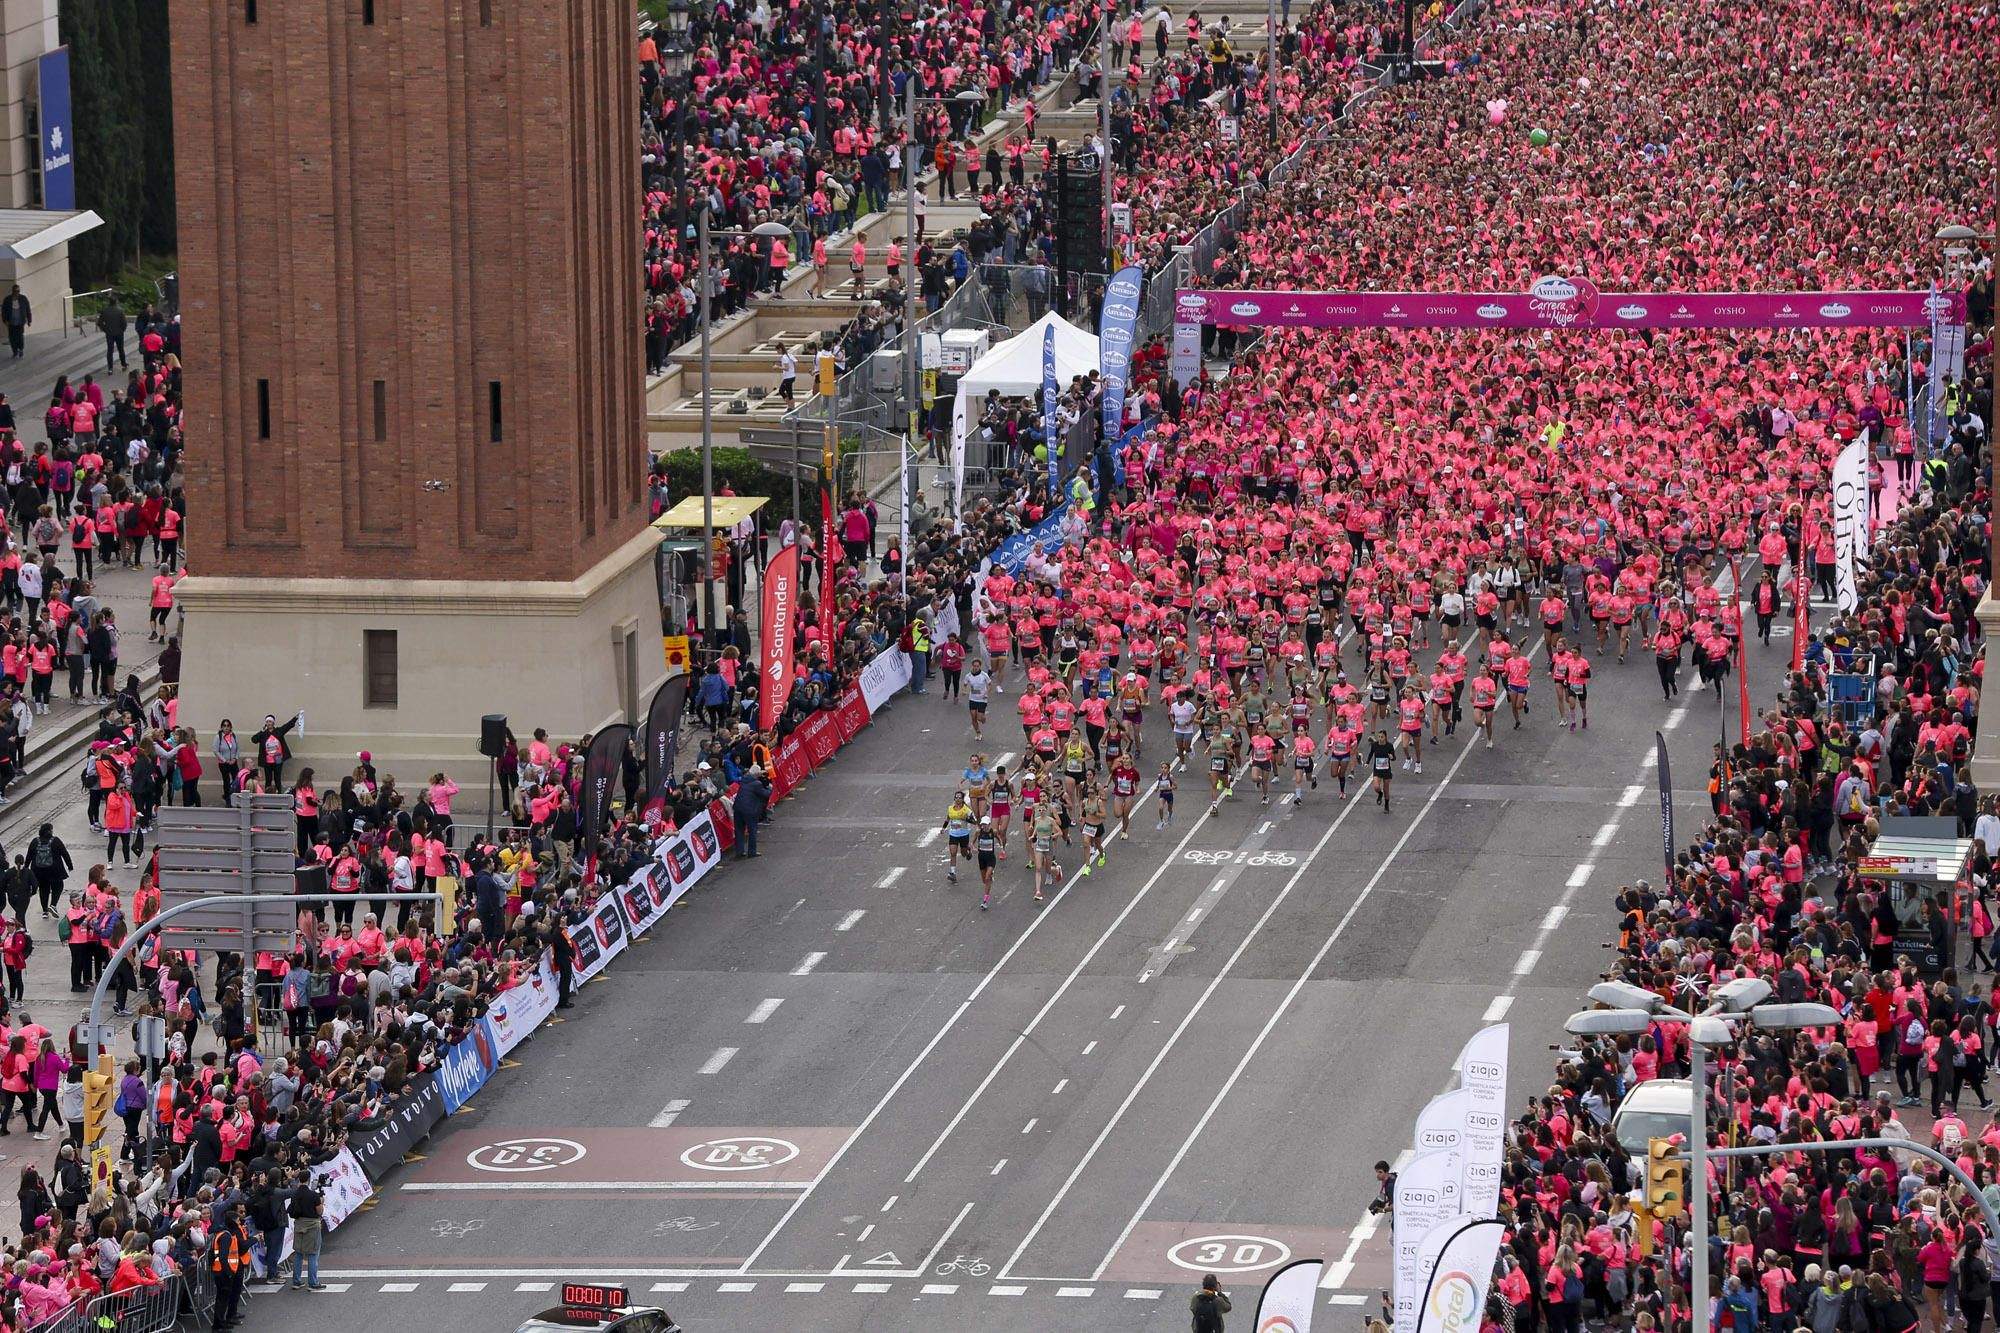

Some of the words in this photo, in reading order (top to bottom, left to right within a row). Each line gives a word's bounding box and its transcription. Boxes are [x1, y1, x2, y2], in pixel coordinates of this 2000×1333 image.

[1537, 288, 1575, 296] ASTURIANA
[1326, 306, 1357, 314] OYSHO
[1529, 299, 1566, 310] Carrera
[1870, 306, 1903, 314] OYSHO
[1426, 307, 1458, 315] OYSHO
[1714, 307, 1746, 315] OYSHO
[1550, 309, 1580, 327] Mujer
[771, 575, 788, 658] Santander
[440, 1043, 481, 1107] Marlene
[1471, 1065, 1498, 1078] ziaja
[1470, 1115, 1498, 1128] ziaja
[356, 1120, 399, 1162] VOLVO
[1426, 1134, 1456, 1146] ziaja
[1471, 1167, 1497, 1178] ziaja
[1404, 1193, 1435, 1205] ziaja
[1195, 1243, 1265, 1264] 30
[566, 1286, 603, 1305] 00:00
[609, 1290, 622, 1306] 10
